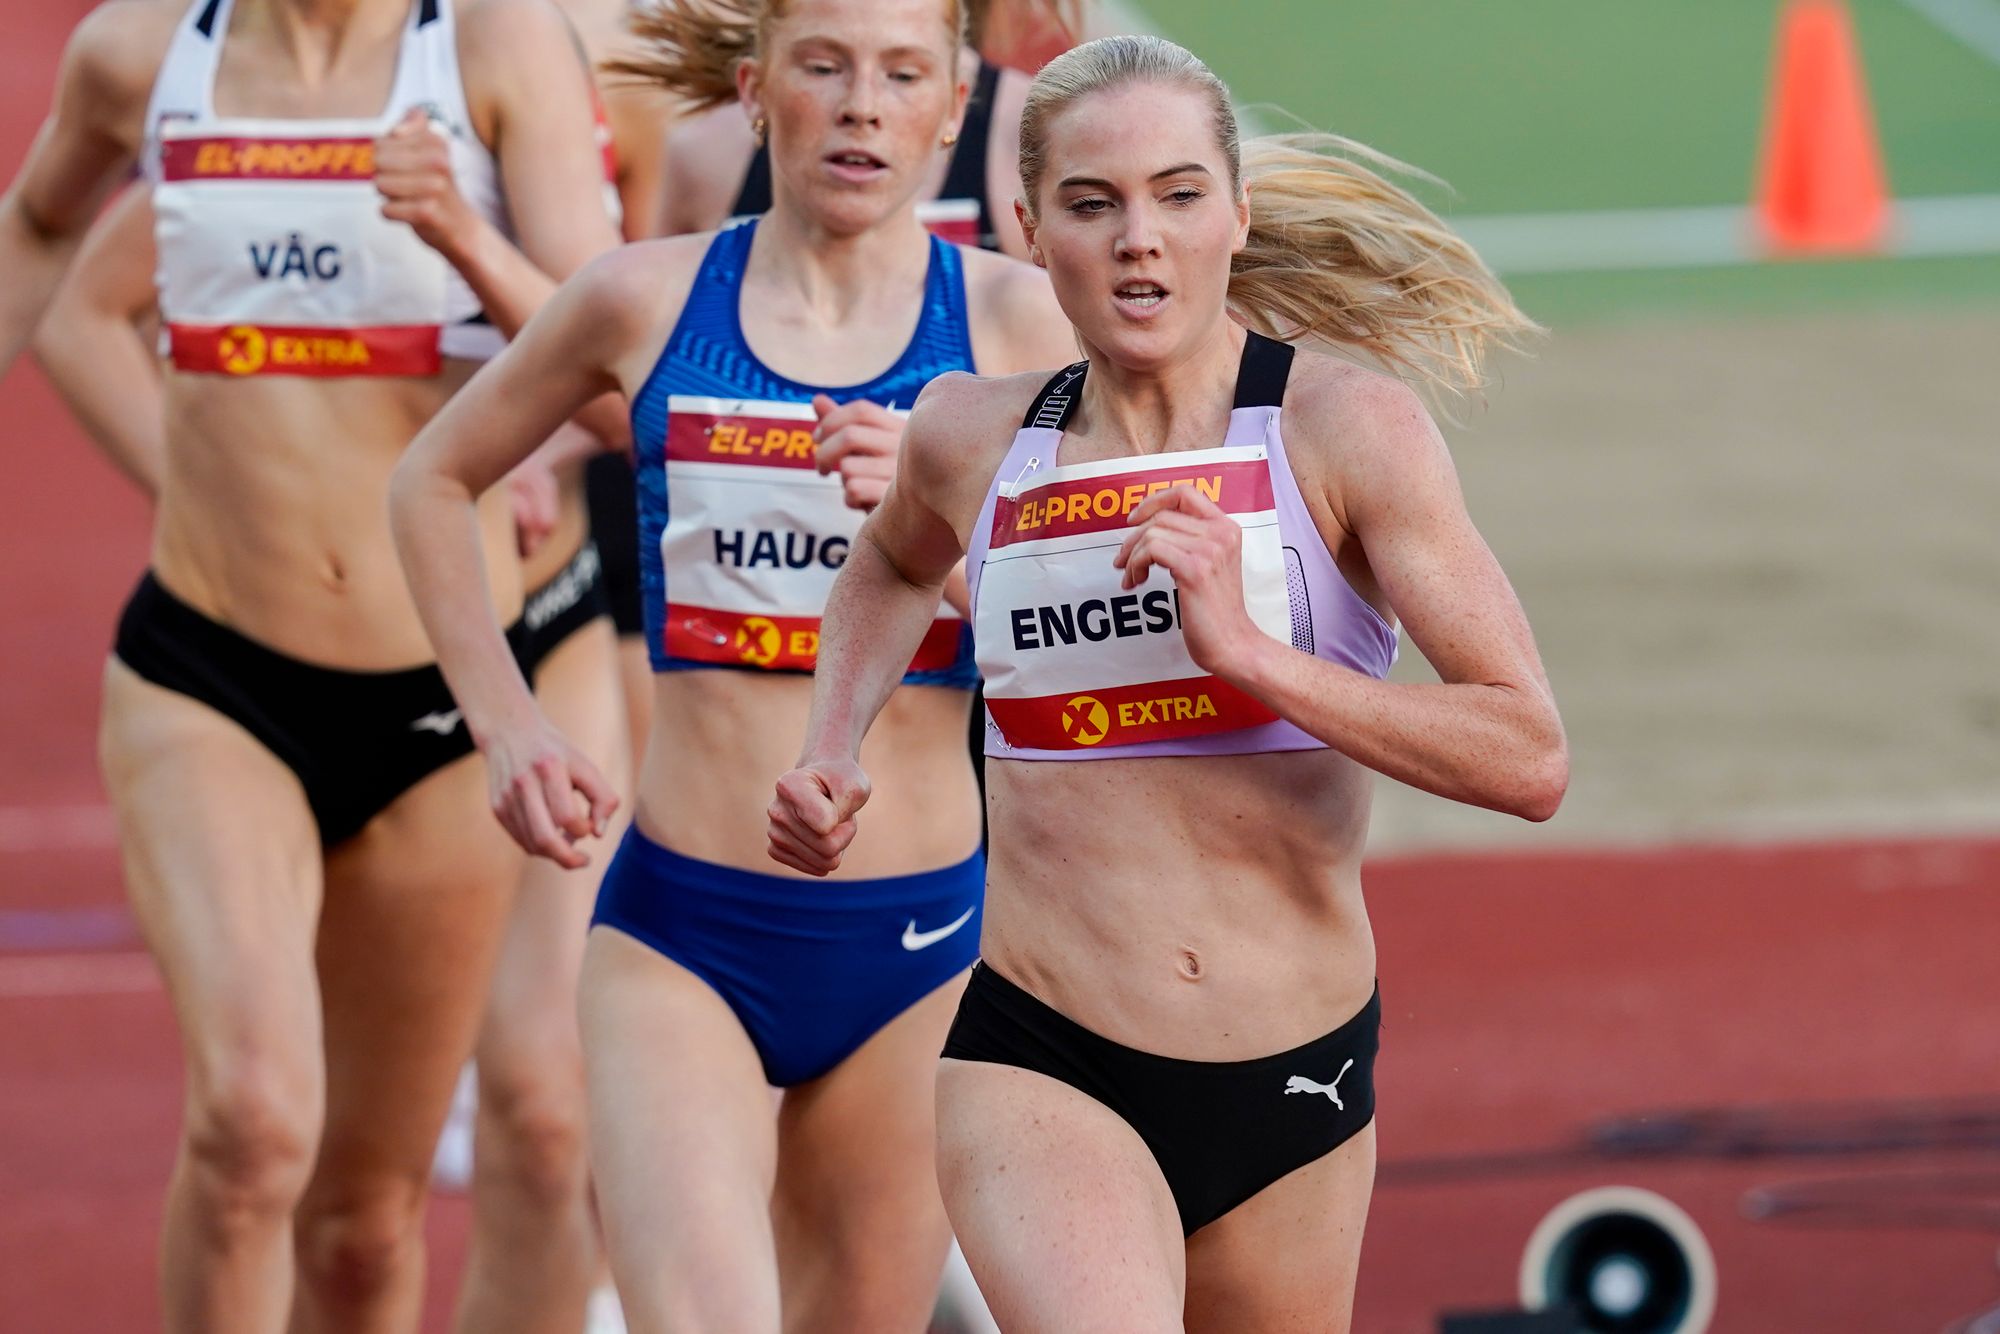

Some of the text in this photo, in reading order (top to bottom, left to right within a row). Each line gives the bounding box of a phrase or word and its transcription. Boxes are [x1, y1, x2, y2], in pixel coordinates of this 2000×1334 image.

[194, 143, 374, 174] EL-PROFFE
[249, 232, 341, 281] VÅG
[271, 336, 369, 366] EXTRA
[709, 425, 819, 459] EL-PR
[1015, 475, 1222, 532] EL-PROFN
[713, 529, 848, 570] HAUG
[1010, 588, 1182, 651] ENGES
[1118, 694, 1218, 728] EXTRA
